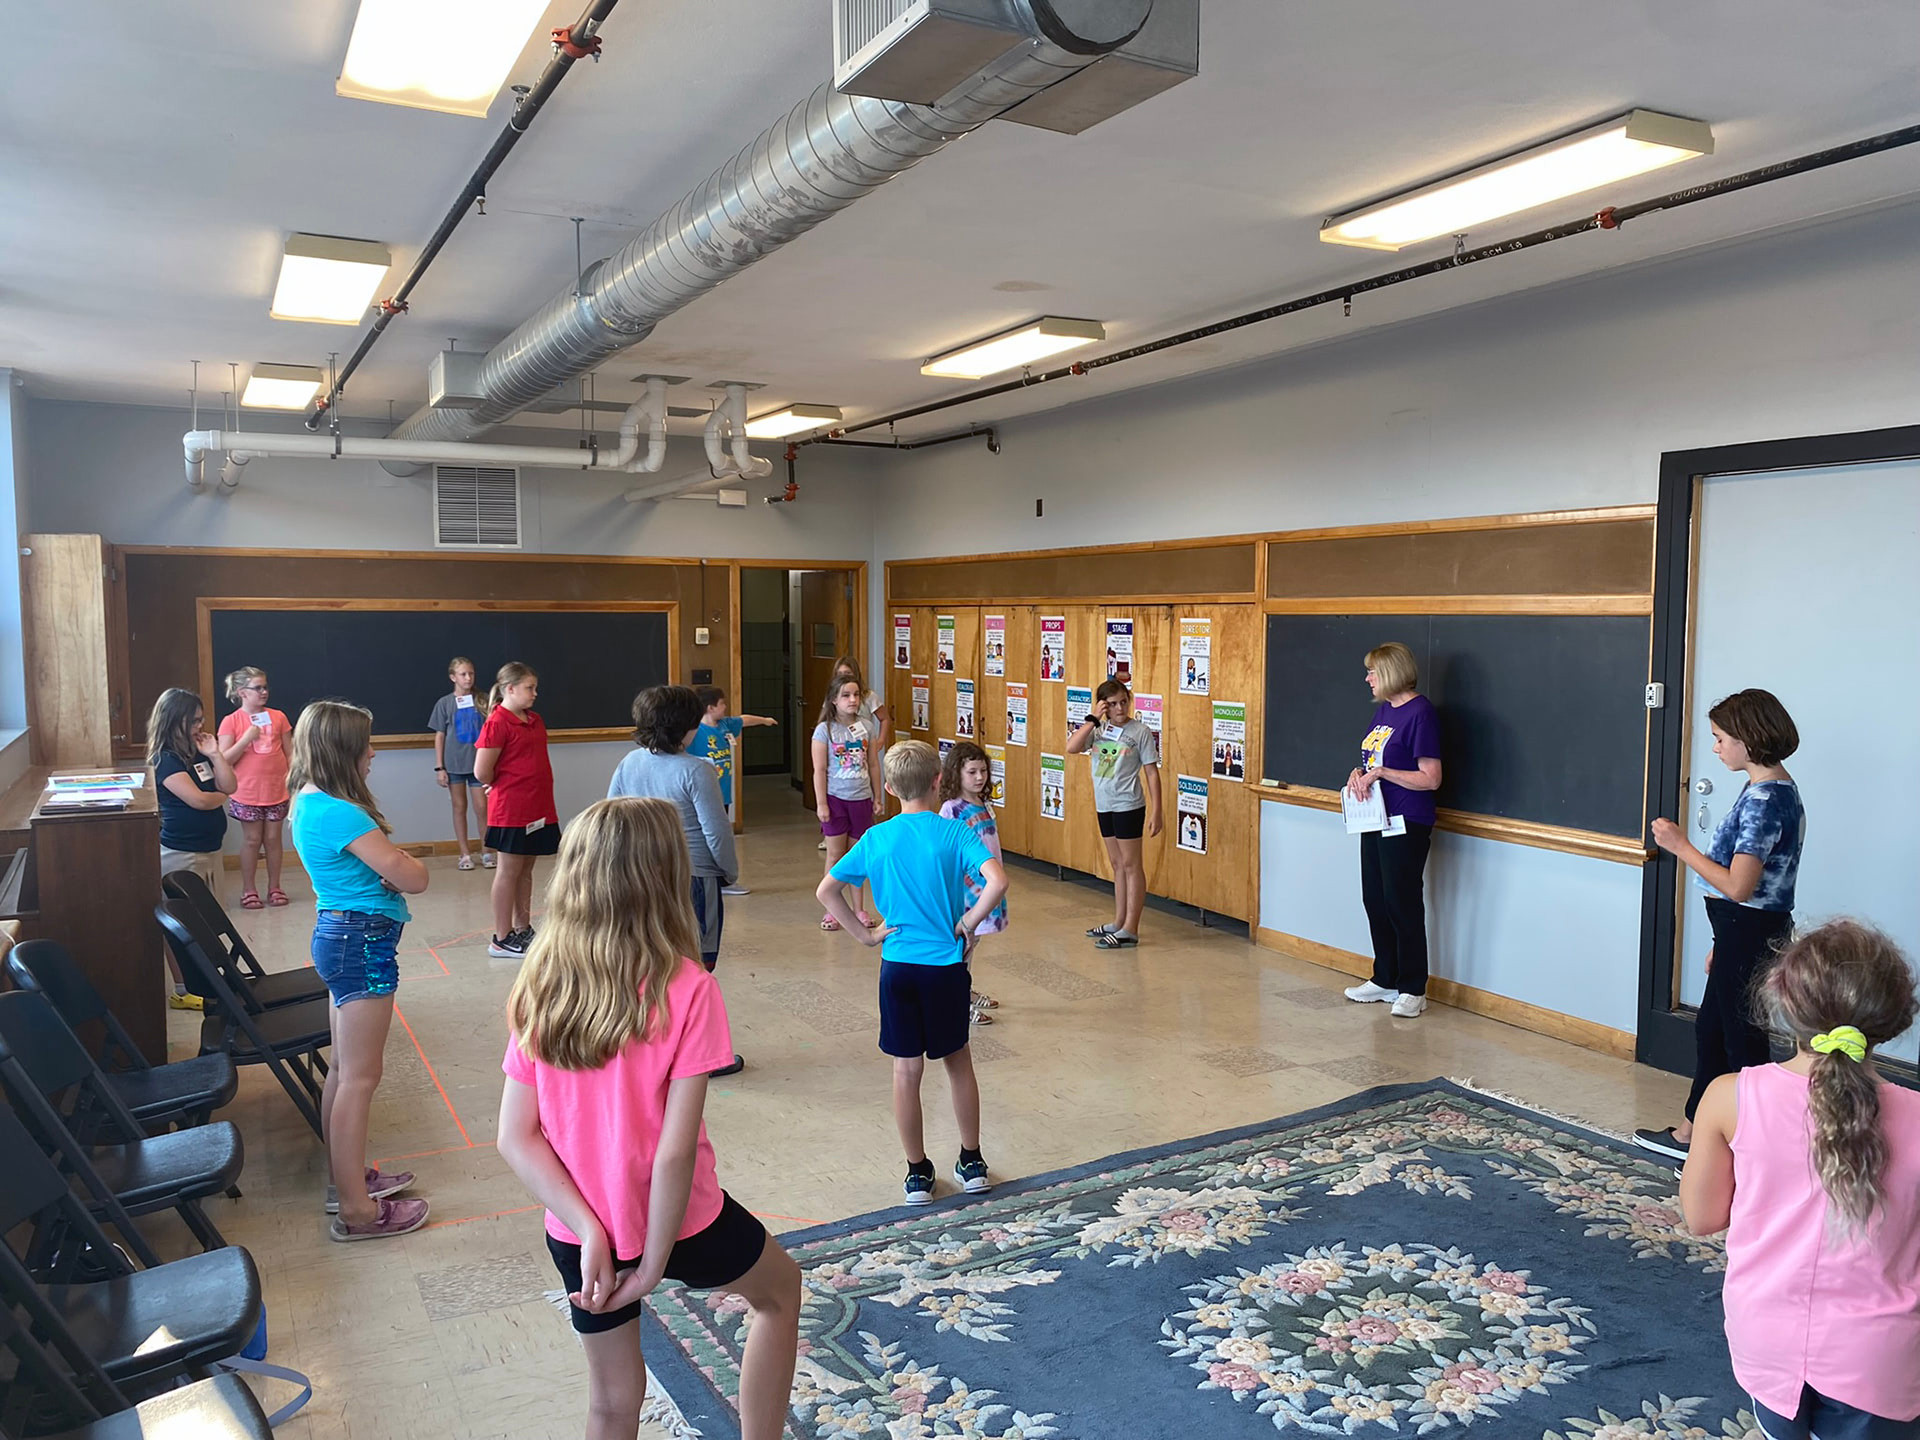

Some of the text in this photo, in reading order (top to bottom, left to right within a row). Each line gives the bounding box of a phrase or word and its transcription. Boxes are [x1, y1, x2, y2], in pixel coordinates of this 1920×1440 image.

[1045, 621, 1061, 630] PROPS
[1112, 624, 1128, 633] STAGE
[1182, 624, 1211, 634] DIRECTOR
[1143, 700, 1153, 708] SET
[1214, 707, 1244, 718] MONOLOGUE
[1178, 781, 1209, 793] SOLILOQUY
